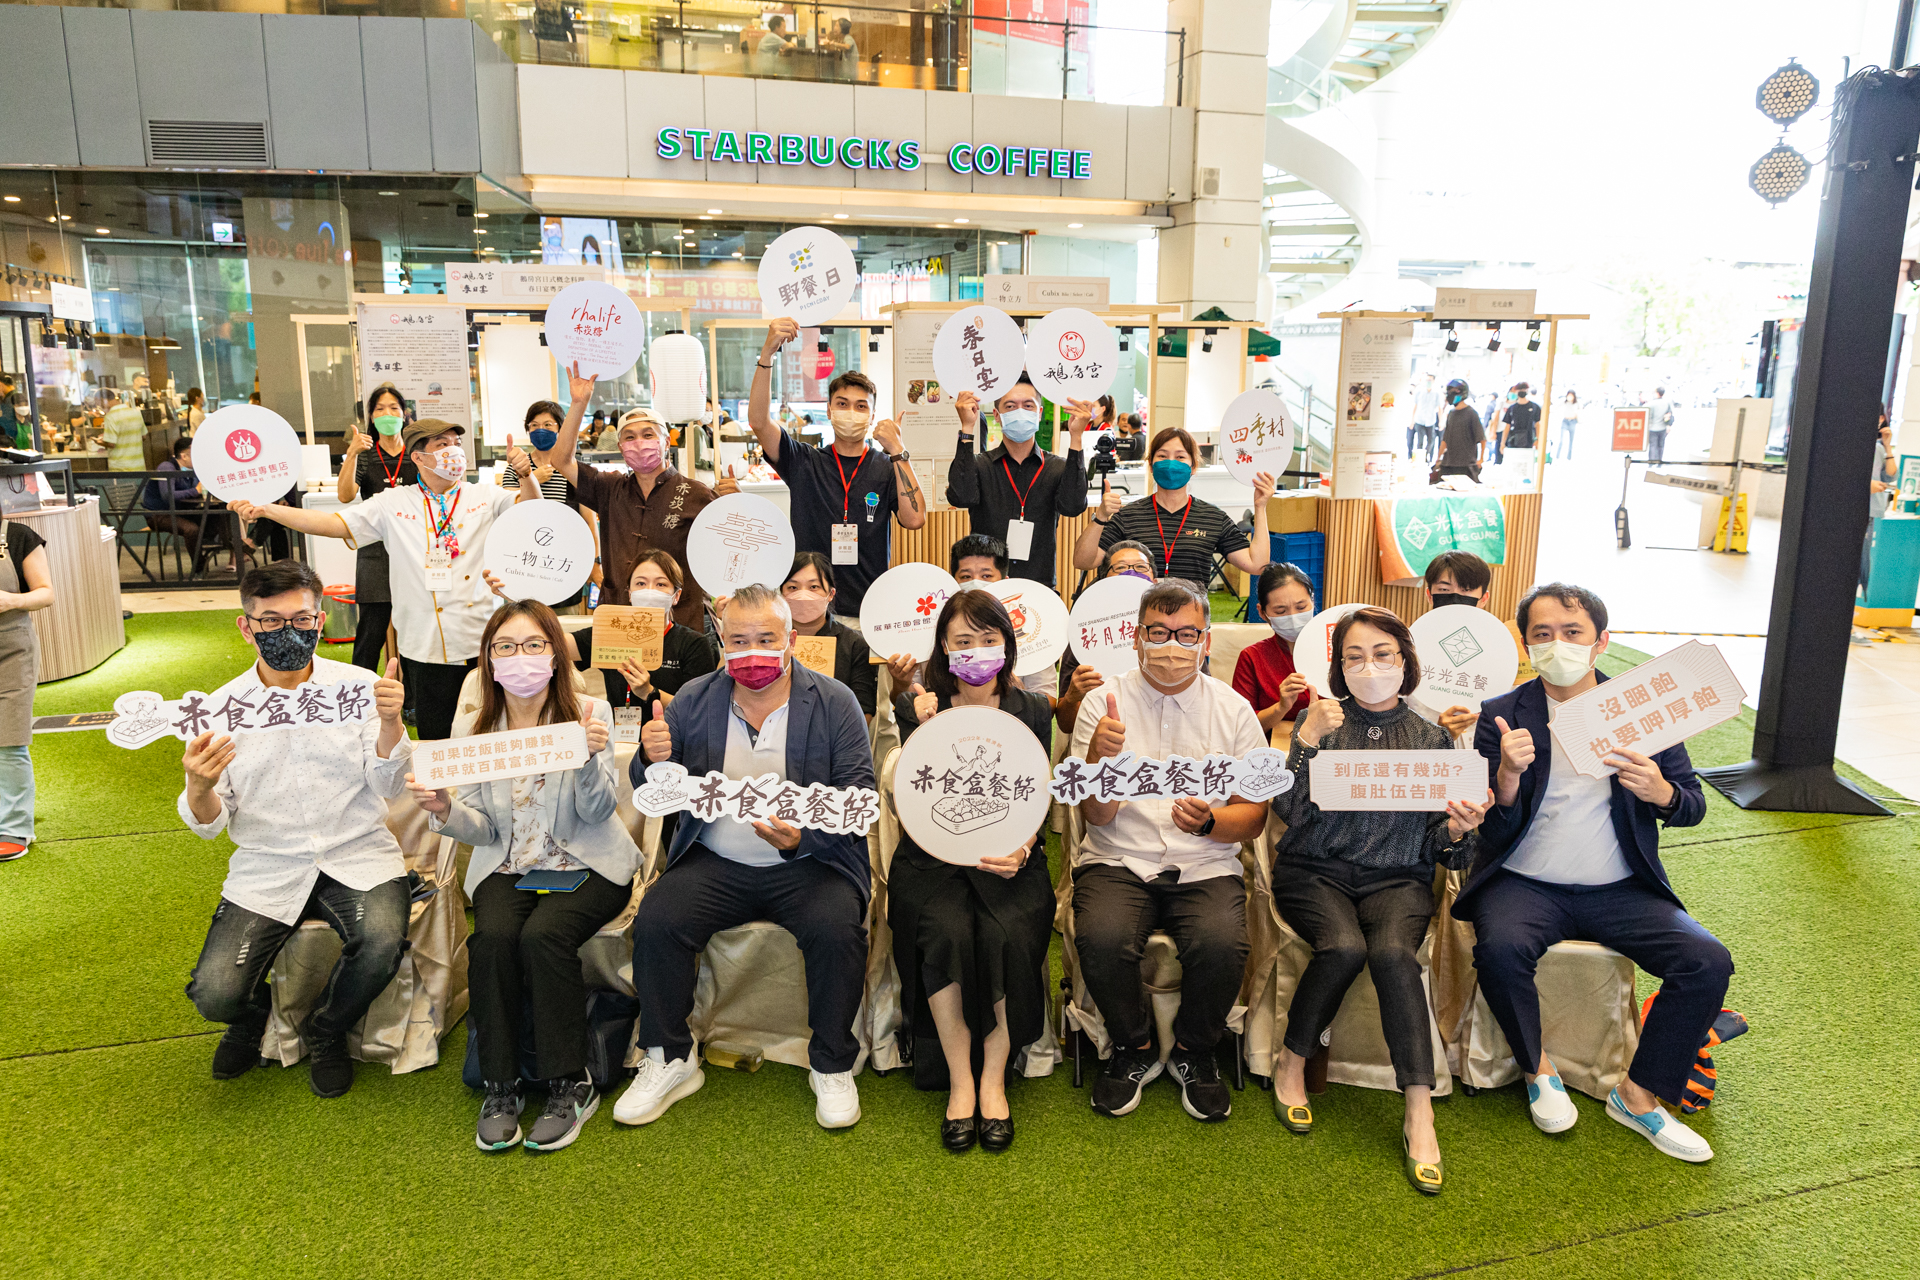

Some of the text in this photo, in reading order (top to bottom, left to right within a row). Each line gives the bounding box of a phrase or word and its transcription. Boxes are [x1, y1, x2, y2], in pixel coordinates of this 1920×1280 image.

[656, 126, 1092, 180] STARBUCKS COFFEE
[991, 295, 1021, 303] 一物立方
[571, 299, 621, 331] rhalife
[574, 323, 603, 337] 赤崁糖
[962, 325, 999, 392] 春日宴
[1229, 412, 1284, 446] 四季村
[1617, 418, 1643, 430] 入口
[216, 461, 289, 484] 佳樂蛋糕專售店
[662, 482, 691, 529] 赤崁糖
[1434, 508, 1498, 532] 光光盒餐
[1470, 531, 1500, 541] GUANG
[503, 551, 573, 573] 一物立方
[505, 567, 525, 576] Cubix
[1087, 617, 1109, 626] SHANGHAI
[1110, 609, 1138, 619] RESTAURANT
[1420, 665, 1488, 691] 光光盒餐
[1429, 684, 1474, 698] GUANG GUANG
[1597, 671, 1678, 721] 沒睏飽
[1589, 685, 1721, 759] 也要呷厚飽
[430, 750, 574, 780] 我早就百萬富翁了XD
[1350, 784, 1447, 800] 腹肚伍告腰
